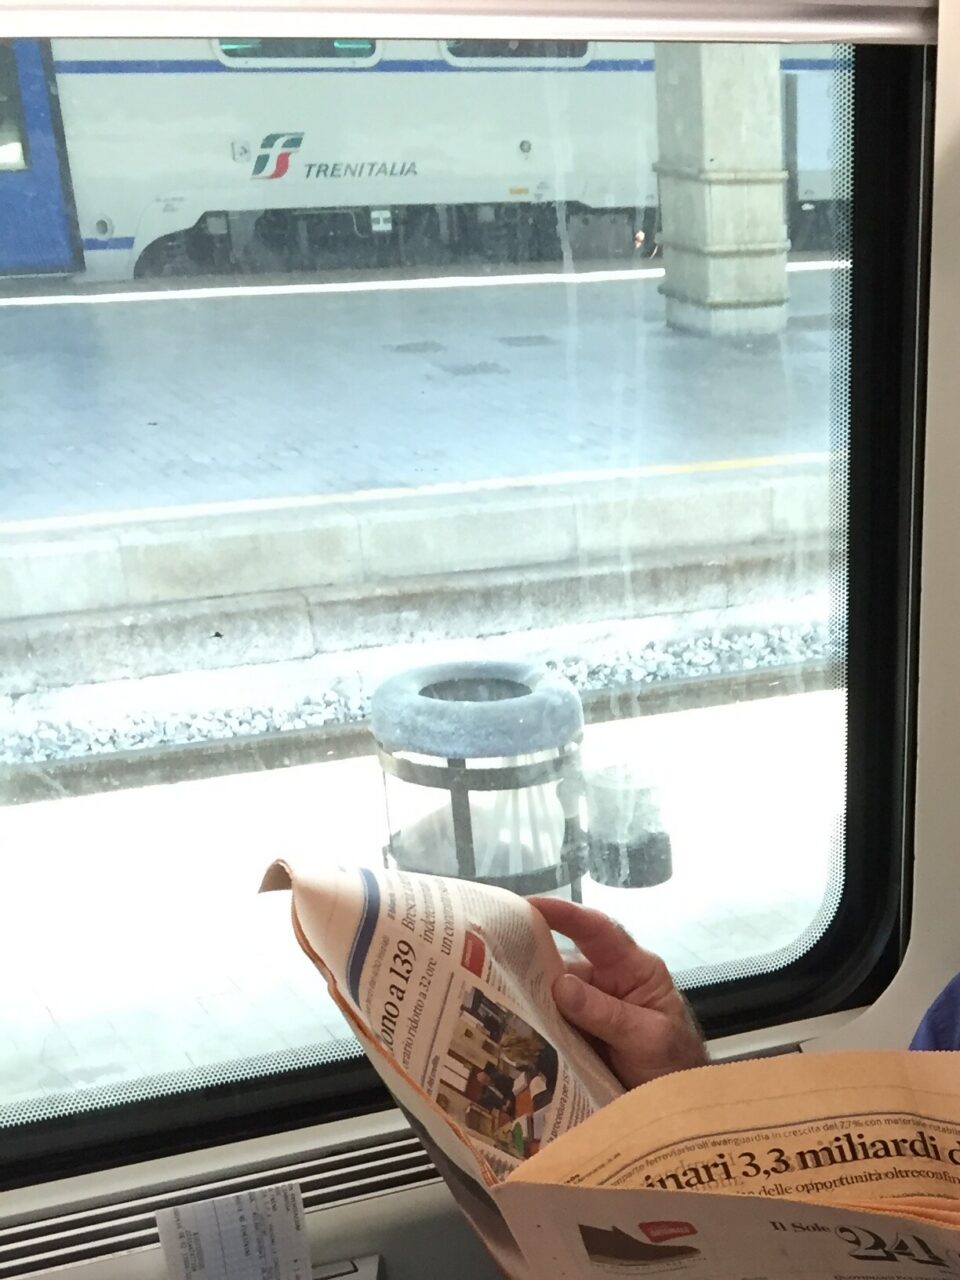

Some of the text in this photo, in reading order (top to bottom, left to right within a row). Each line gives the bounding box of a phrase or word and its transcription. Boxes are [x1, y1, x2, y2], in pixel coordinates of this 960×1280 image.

[304, 161, 418, 179] TRENITALIA
[389, 940, 417, 1002] a 139
[407, 1002, 424, 1034] ridotto
[419, 976, 432, 993] 32
[426, 957, 438, 977] ore
[737, 1147, 791, 1180] 3,3
[795, 1130, 941, 1171] miliardi
[759, 1182, 794, 1198] delle
[794, 1169, 881, 1194] opportunità
[768, 1220, 789, 1233] Il
[791, 1221, 833, 1233] Sole
